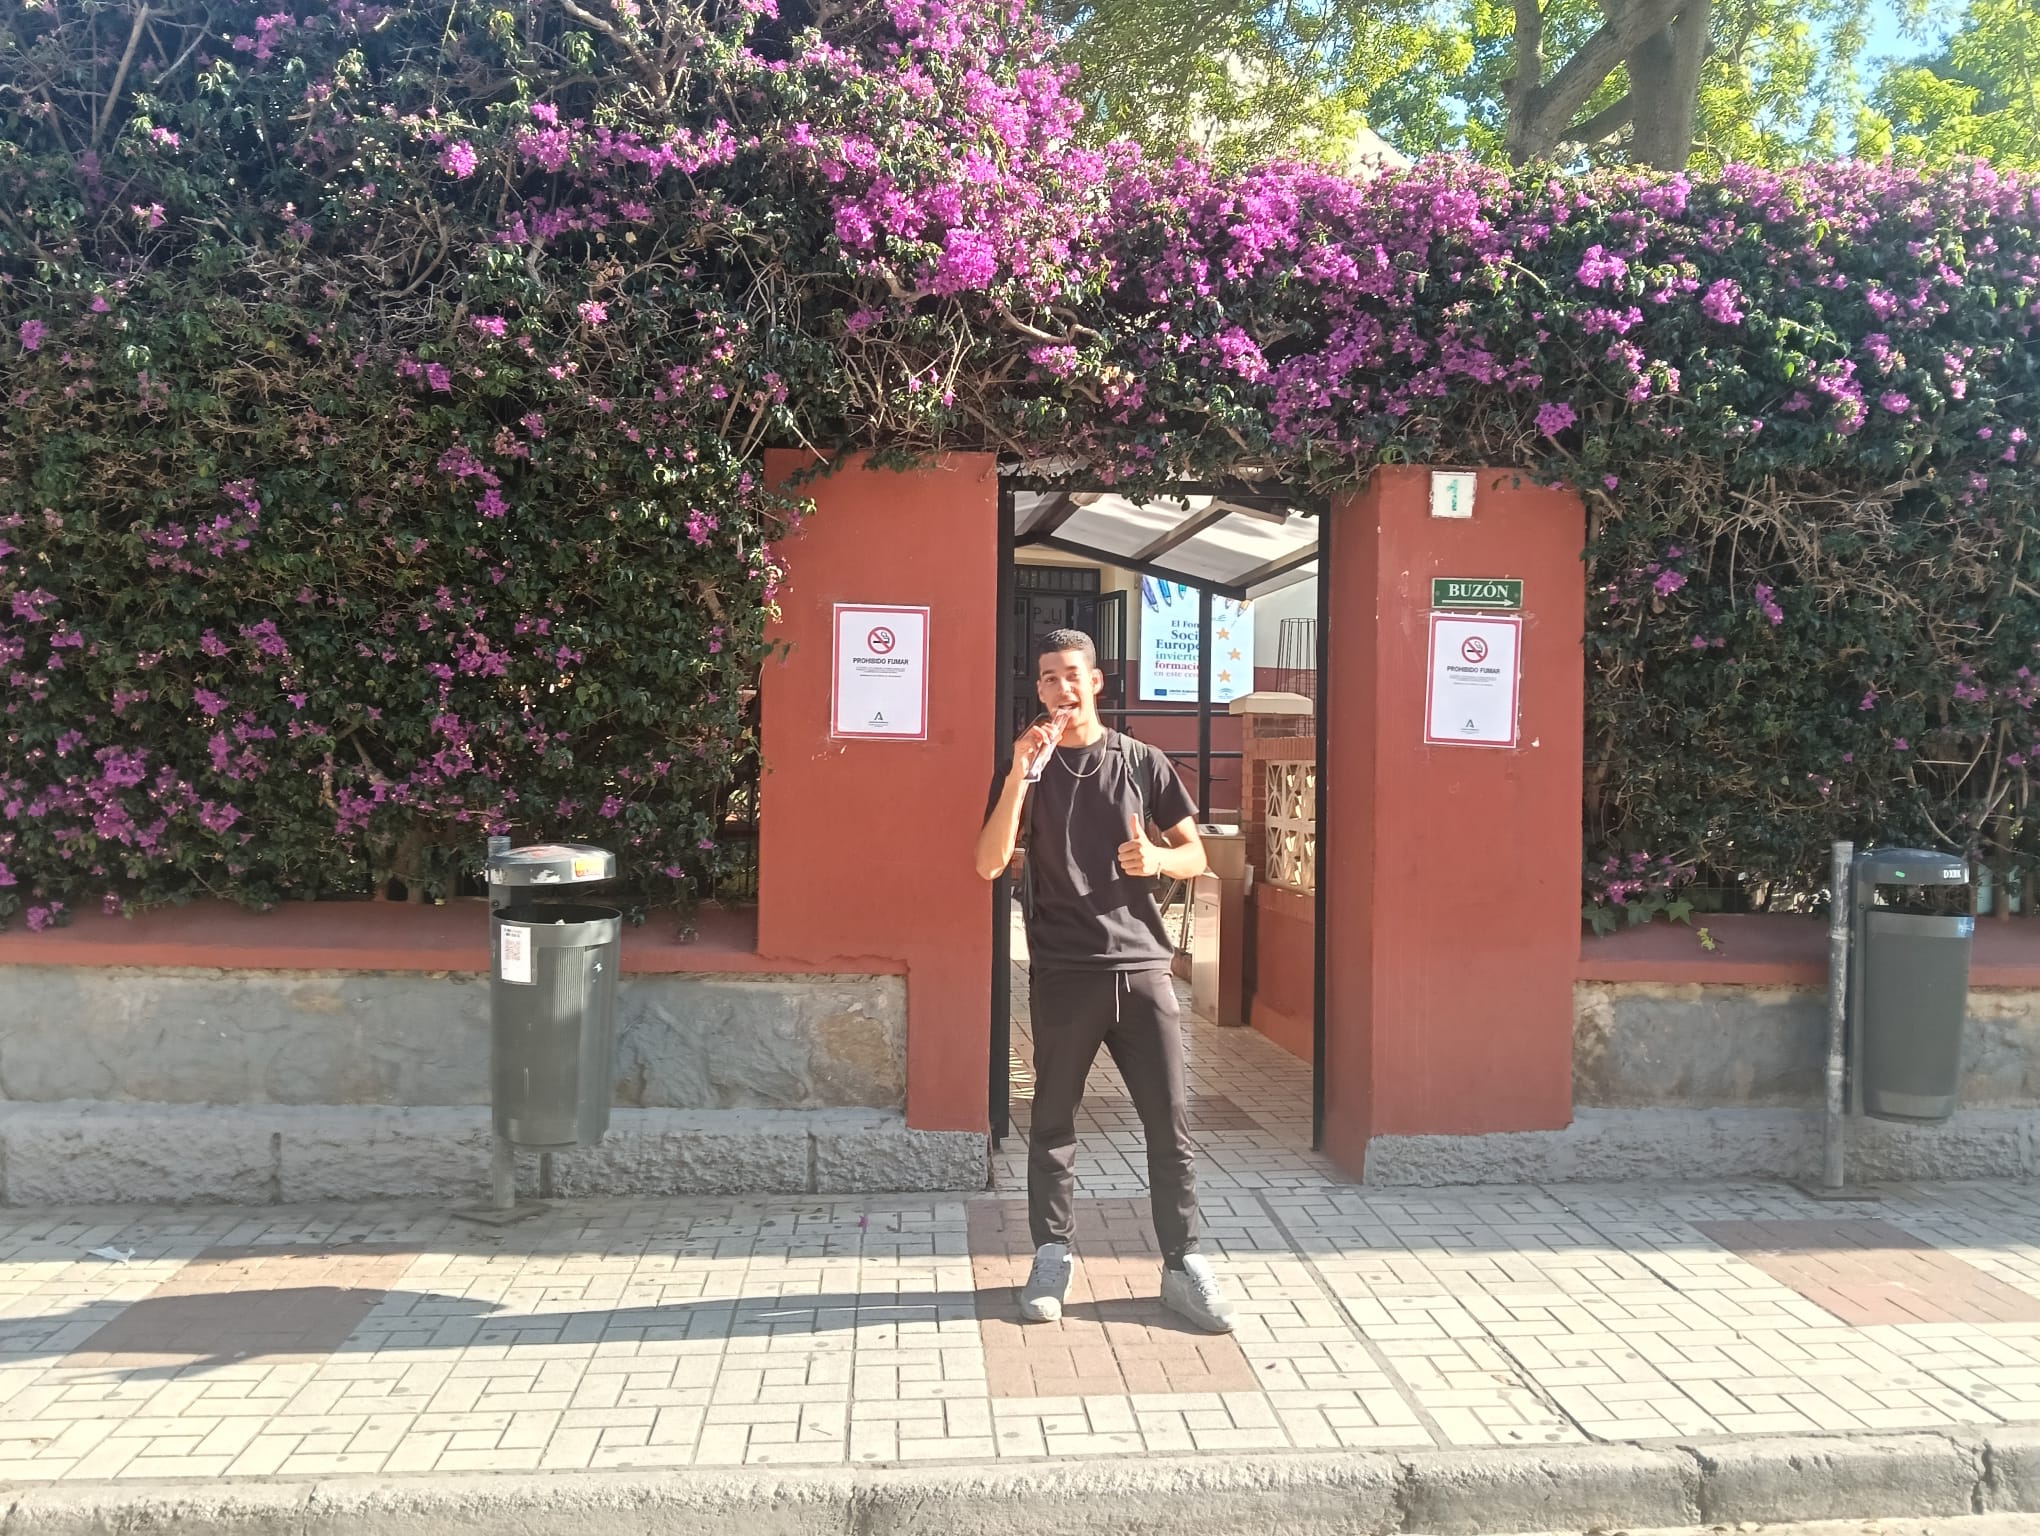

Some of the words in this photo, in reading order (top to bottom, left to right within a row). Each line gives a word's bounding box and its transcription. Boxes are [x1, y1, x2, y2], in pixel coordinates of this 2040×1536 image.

[1447, 479, 1458, 511] 1
[1448, 580, 1509, 598] BUZÓN
[1171, 620, 1180, 628] El
[1183, 620, 1200, 628] Fon
[1171, 629, 1199, 640] Soci
